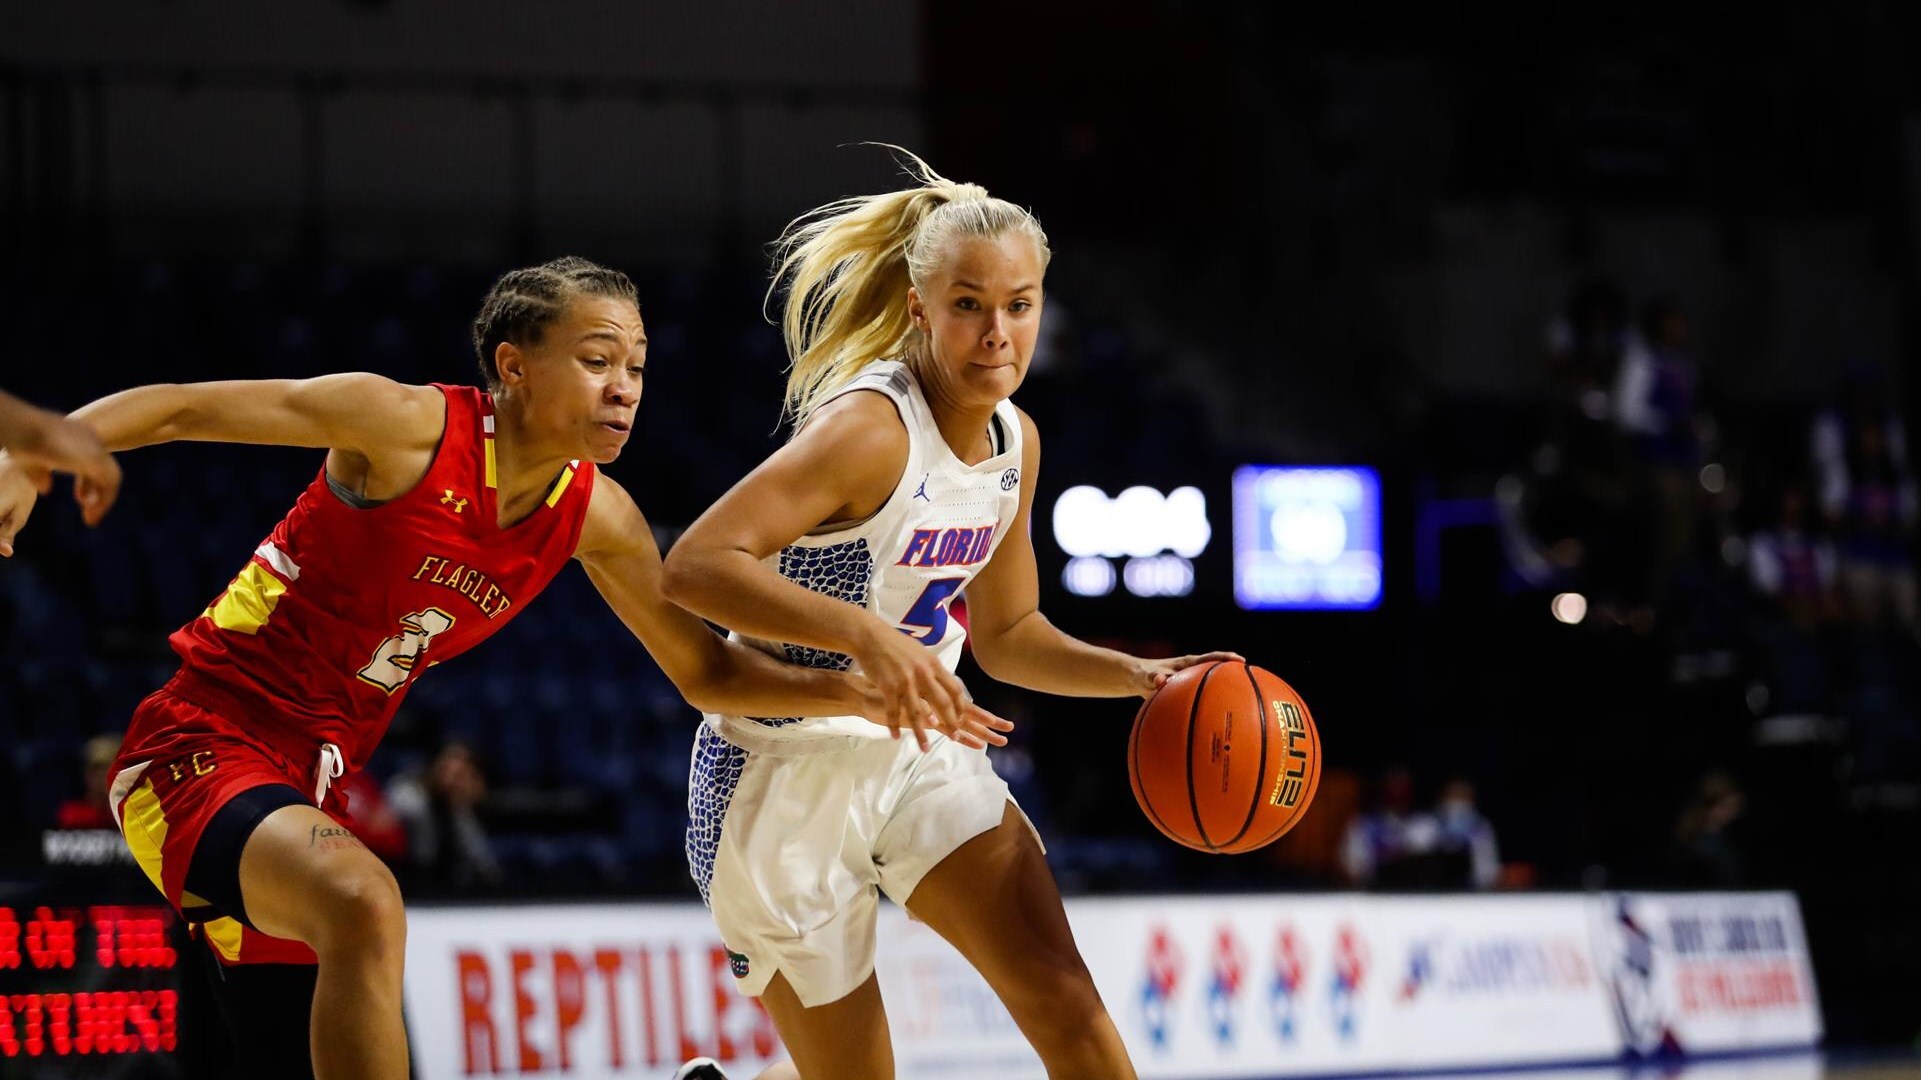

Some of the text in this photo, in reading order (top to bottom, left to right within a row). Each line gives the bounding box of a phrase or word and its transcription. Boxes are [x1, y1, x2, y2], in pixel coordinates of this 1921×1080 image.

[357, 607, 456, 696] 2
[897, 577, 966, 647] 5
[1277, 702, 1307, 807] ELITE
